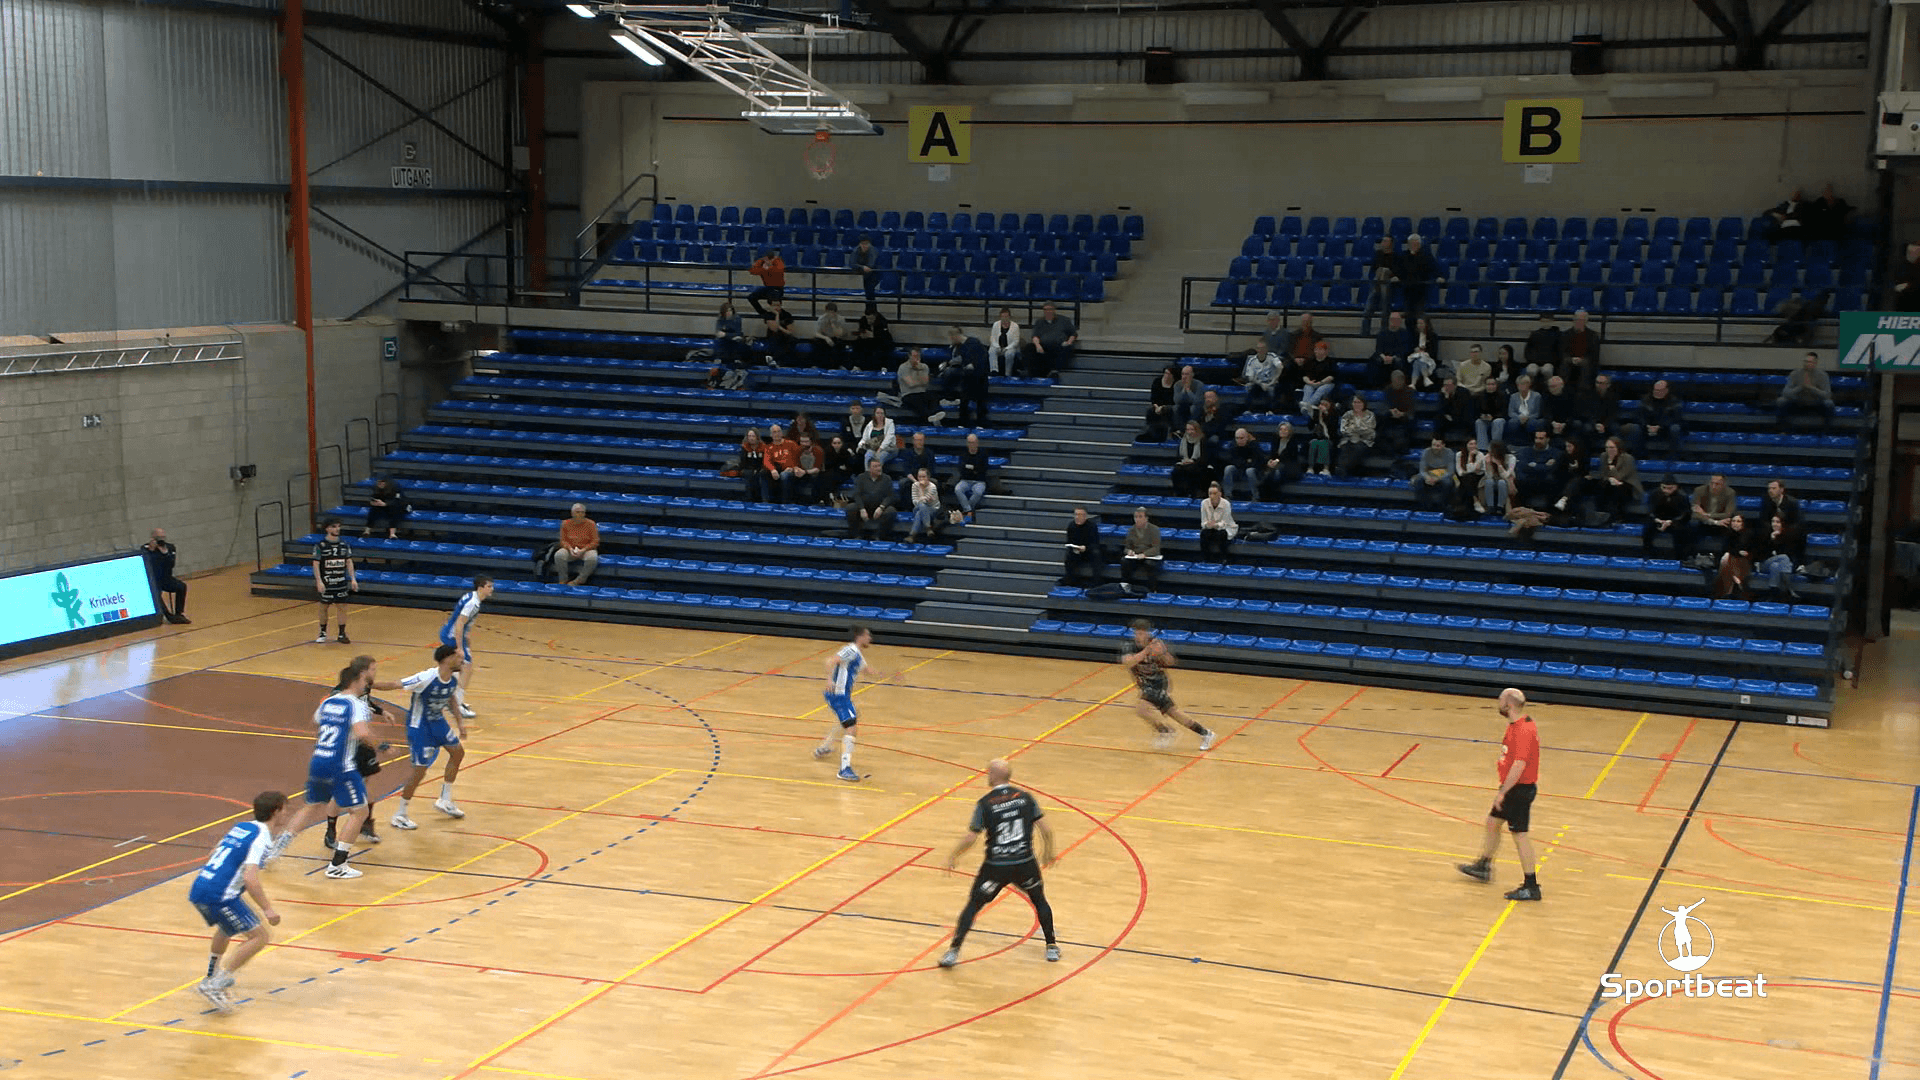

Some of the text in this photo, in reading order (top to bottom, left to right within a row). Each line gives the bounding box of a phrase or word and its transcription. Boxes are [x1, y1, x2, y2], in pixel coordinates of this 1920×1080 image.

[919, 111, 960, 156] A
[1519, 106, 1562, 156] B
[393, 167, 432, 187] UITGANG
[332, 547, 339, 557] 2
[89, 591, 126, 609] Krinkels
[317, 723, 340, 748] 22
